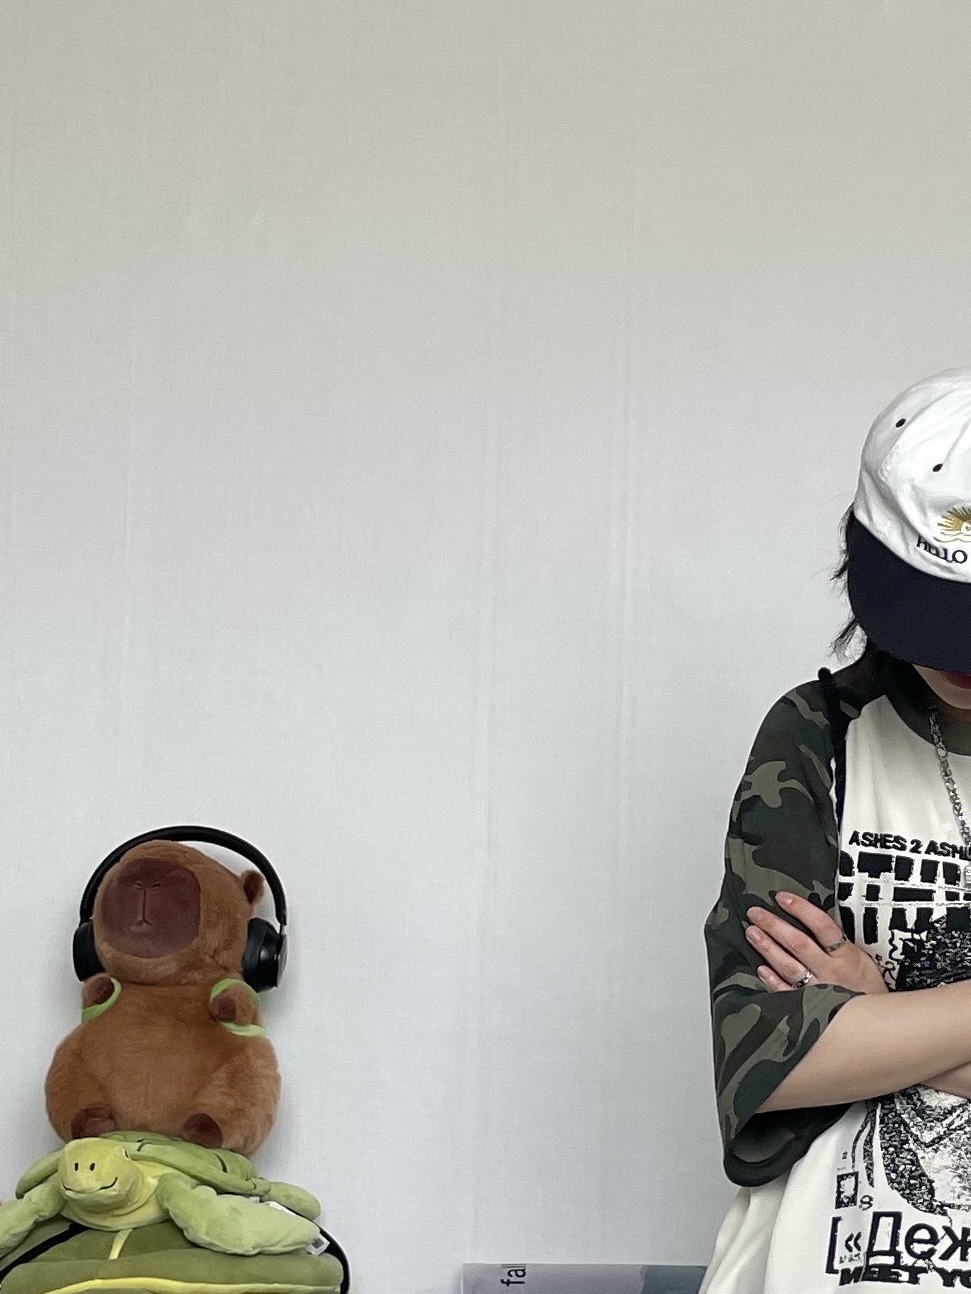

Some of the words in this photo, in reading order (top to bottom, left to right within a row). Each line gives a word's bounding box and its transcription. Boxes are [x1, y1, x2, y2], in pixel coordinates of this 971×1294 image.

[916, 535, 968, 564] HELLO
[848, 830, 908, 852] ASHES
[910, 839, 923, 855] 2
